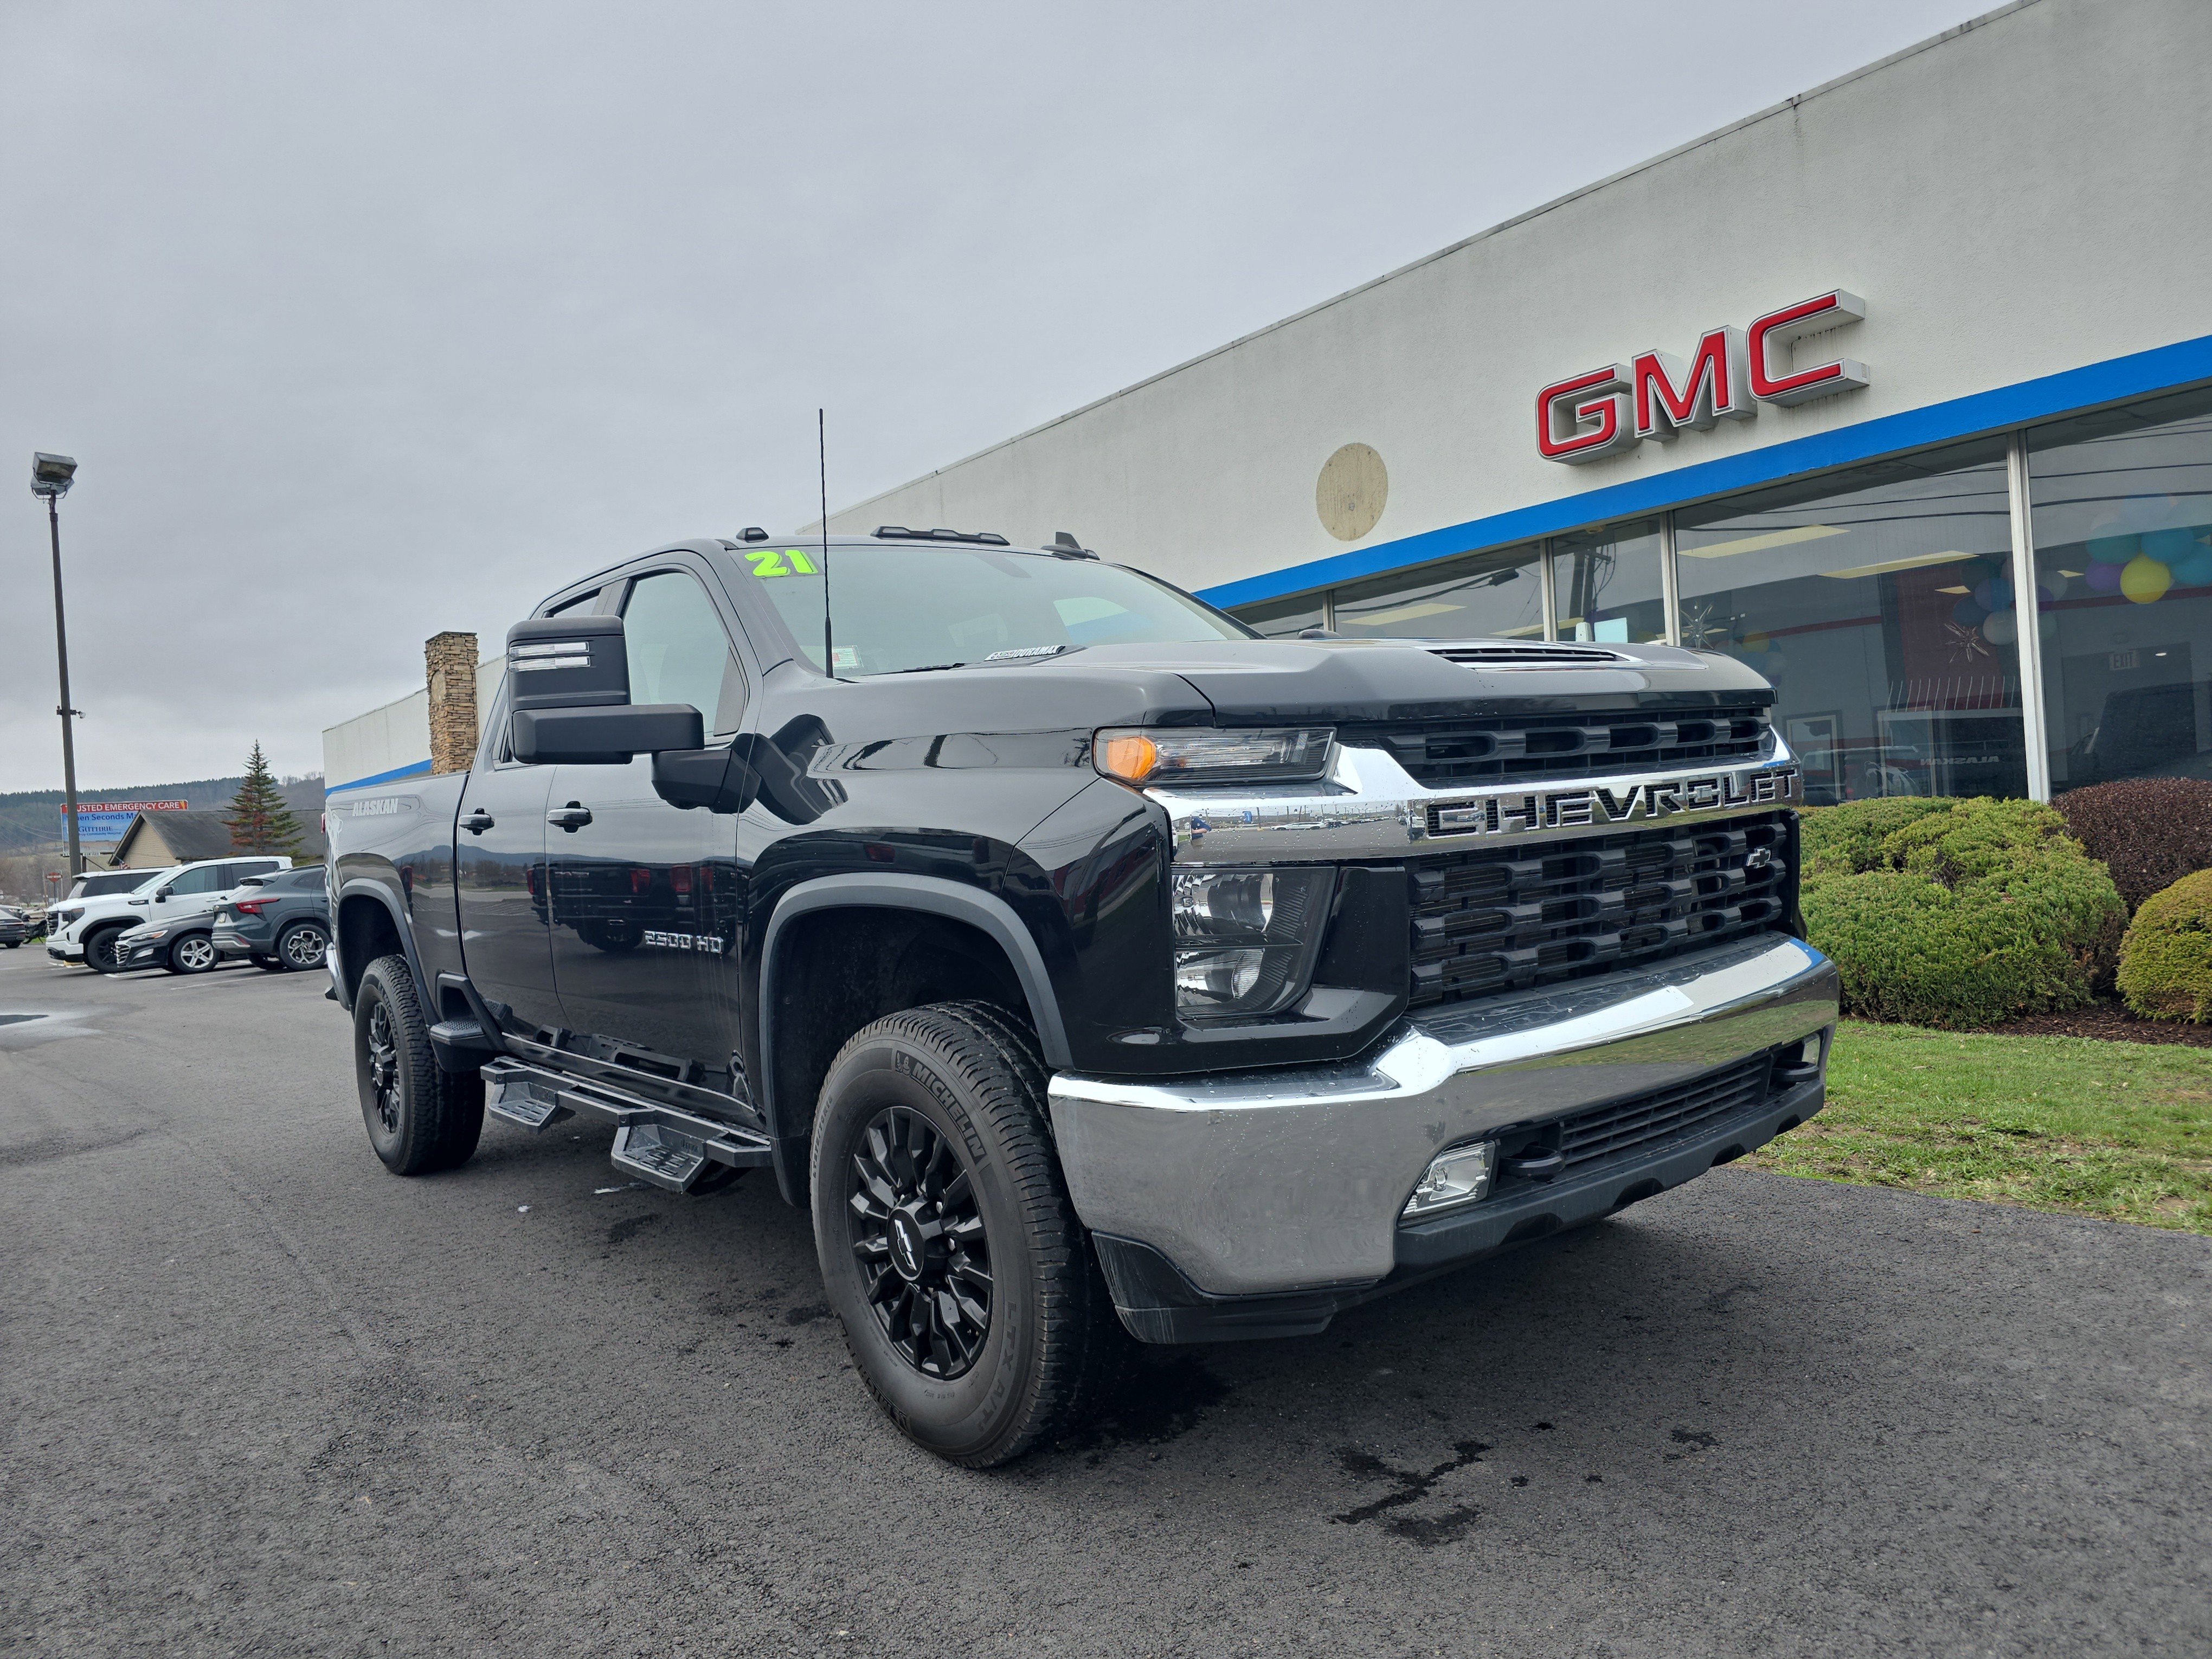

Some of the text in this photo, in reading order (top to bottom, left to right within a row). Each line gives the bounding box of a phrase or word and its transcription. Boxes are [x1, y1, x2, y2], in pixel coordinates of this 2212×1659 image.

[1535, 288, 1850, 462] GMC
[744, 550, 818, 577] 21
[1012, 645, 1062, 658] DURAMAX
[2113, 652, 2133, 668] EXIT
[92, 812, 124, 820] Seconds
[105, 802, 156, 811] EMERGENCY
[158, 801, 180, 809] CARE
[352, 799, 398, 816] ALASKAN
[1426, 769, 1798, 839] CHEVROLET
[644, 930, 724, 954] 2500 HD
[912, 1062, 985, 1158] MICHELIN
[1002, 1301, 1017, 1372] LTX
